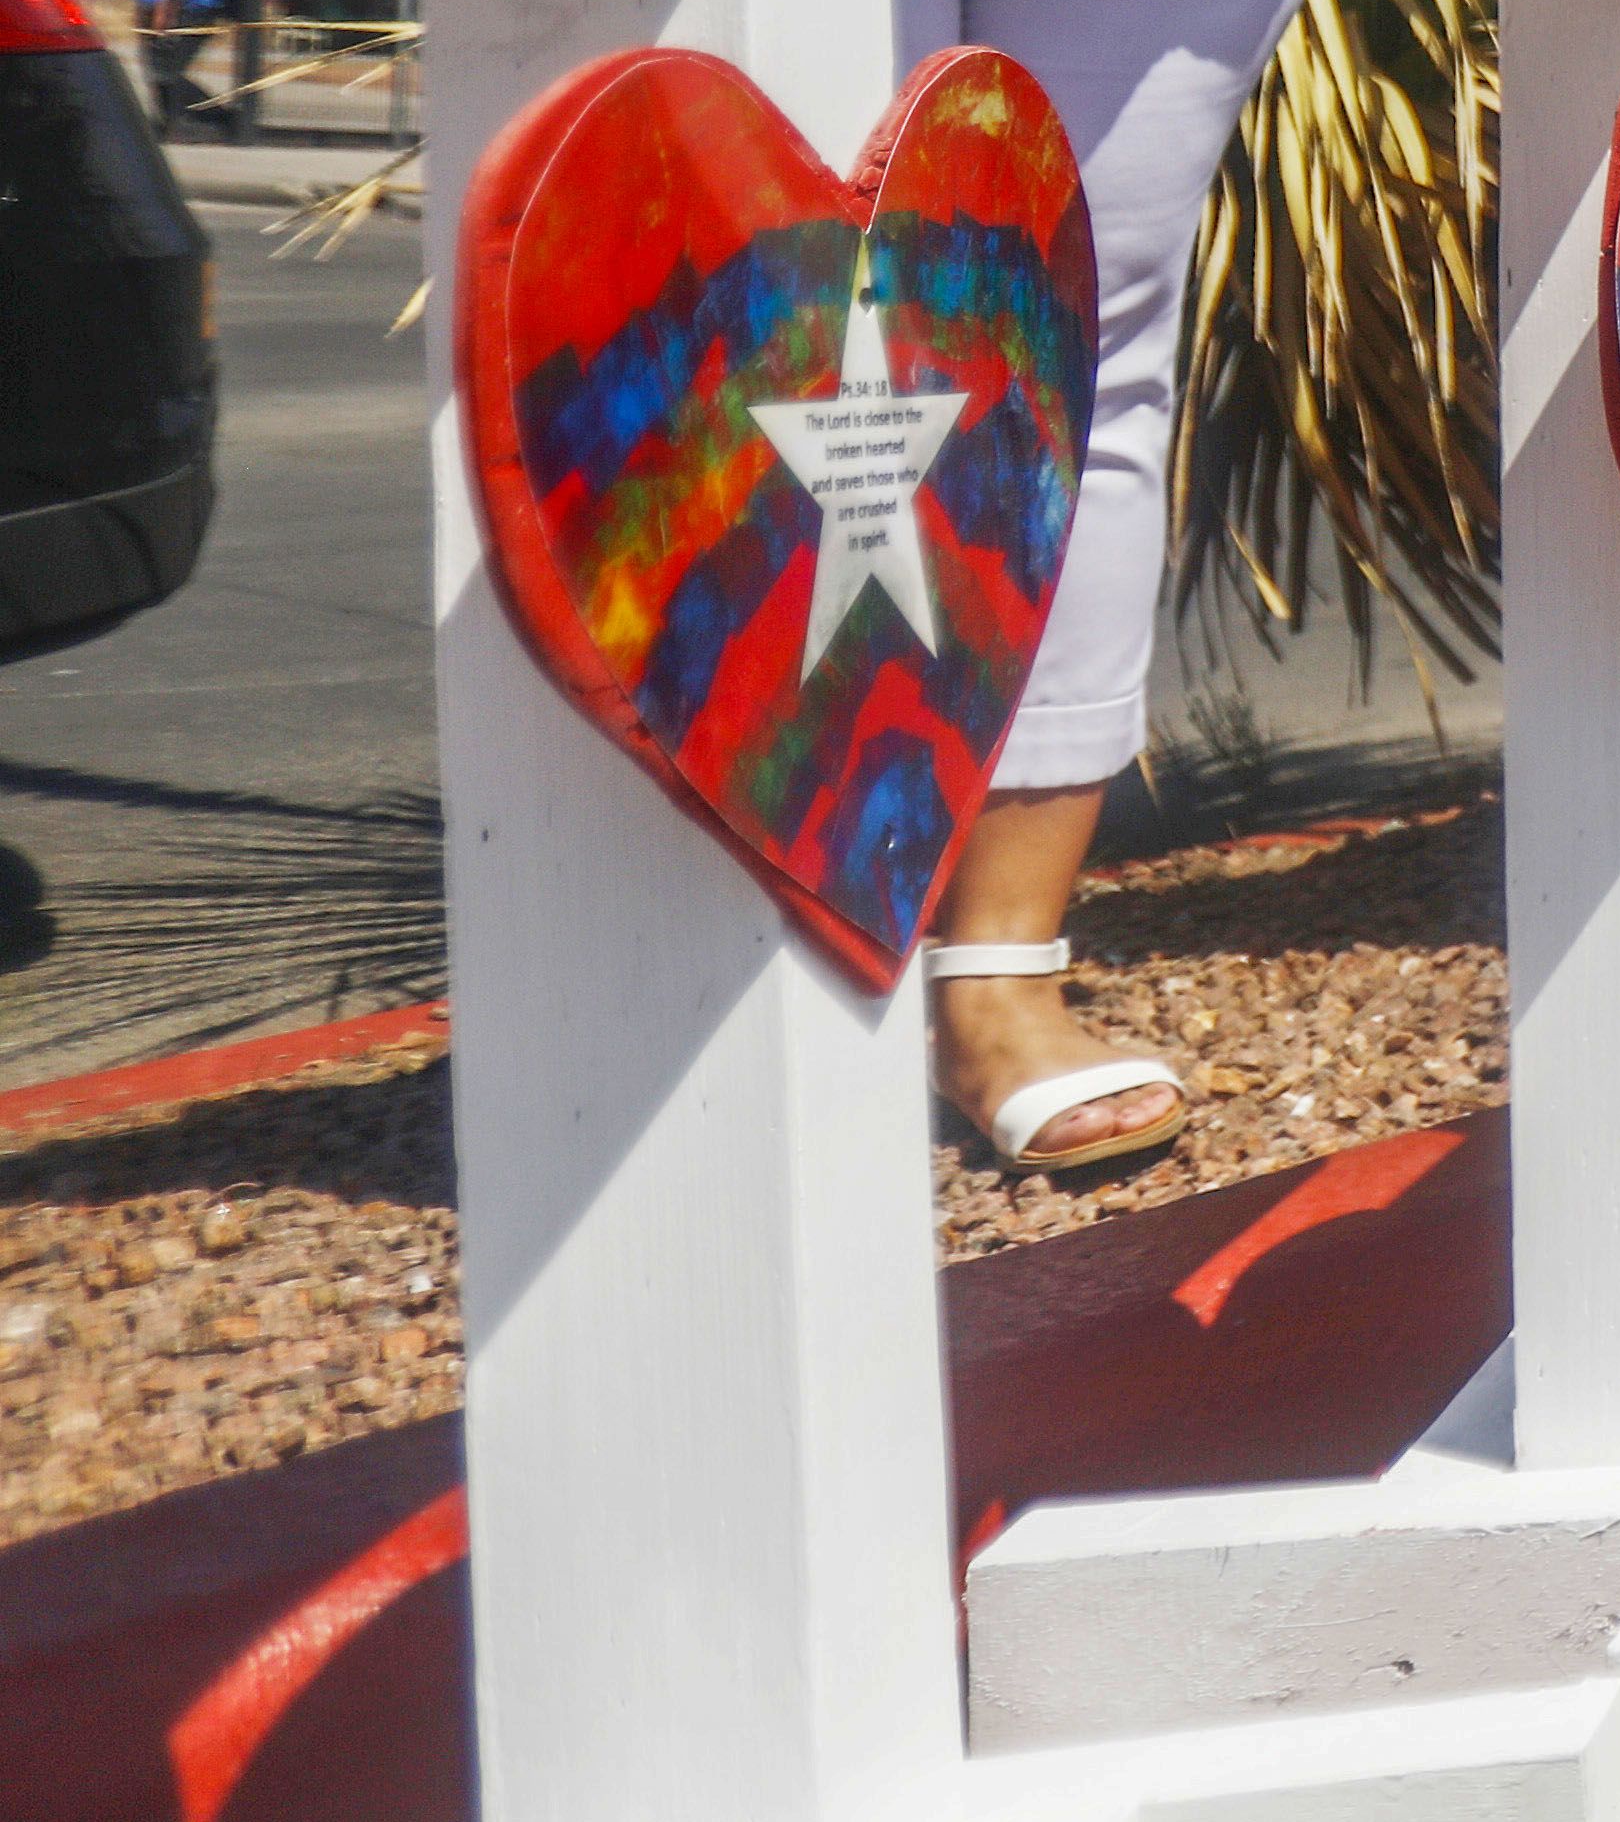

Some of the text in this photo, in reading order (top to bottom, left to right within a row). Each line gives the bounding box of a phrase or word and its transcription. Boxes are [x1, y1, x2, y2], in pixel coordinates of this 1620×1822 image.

[805, 413, 824, 431] The
[827, 411, 850, 430] Lord
[864, 410, 891, 426] close
[905, 406, 922, 424] the
[825, 437, 905, 461] broken hearted
[811, 474, 832, 495] and
[835, 475, 864, 492] saves
[867, 470, 895, 487] those
[838, 497, 897, 522] are crushed
